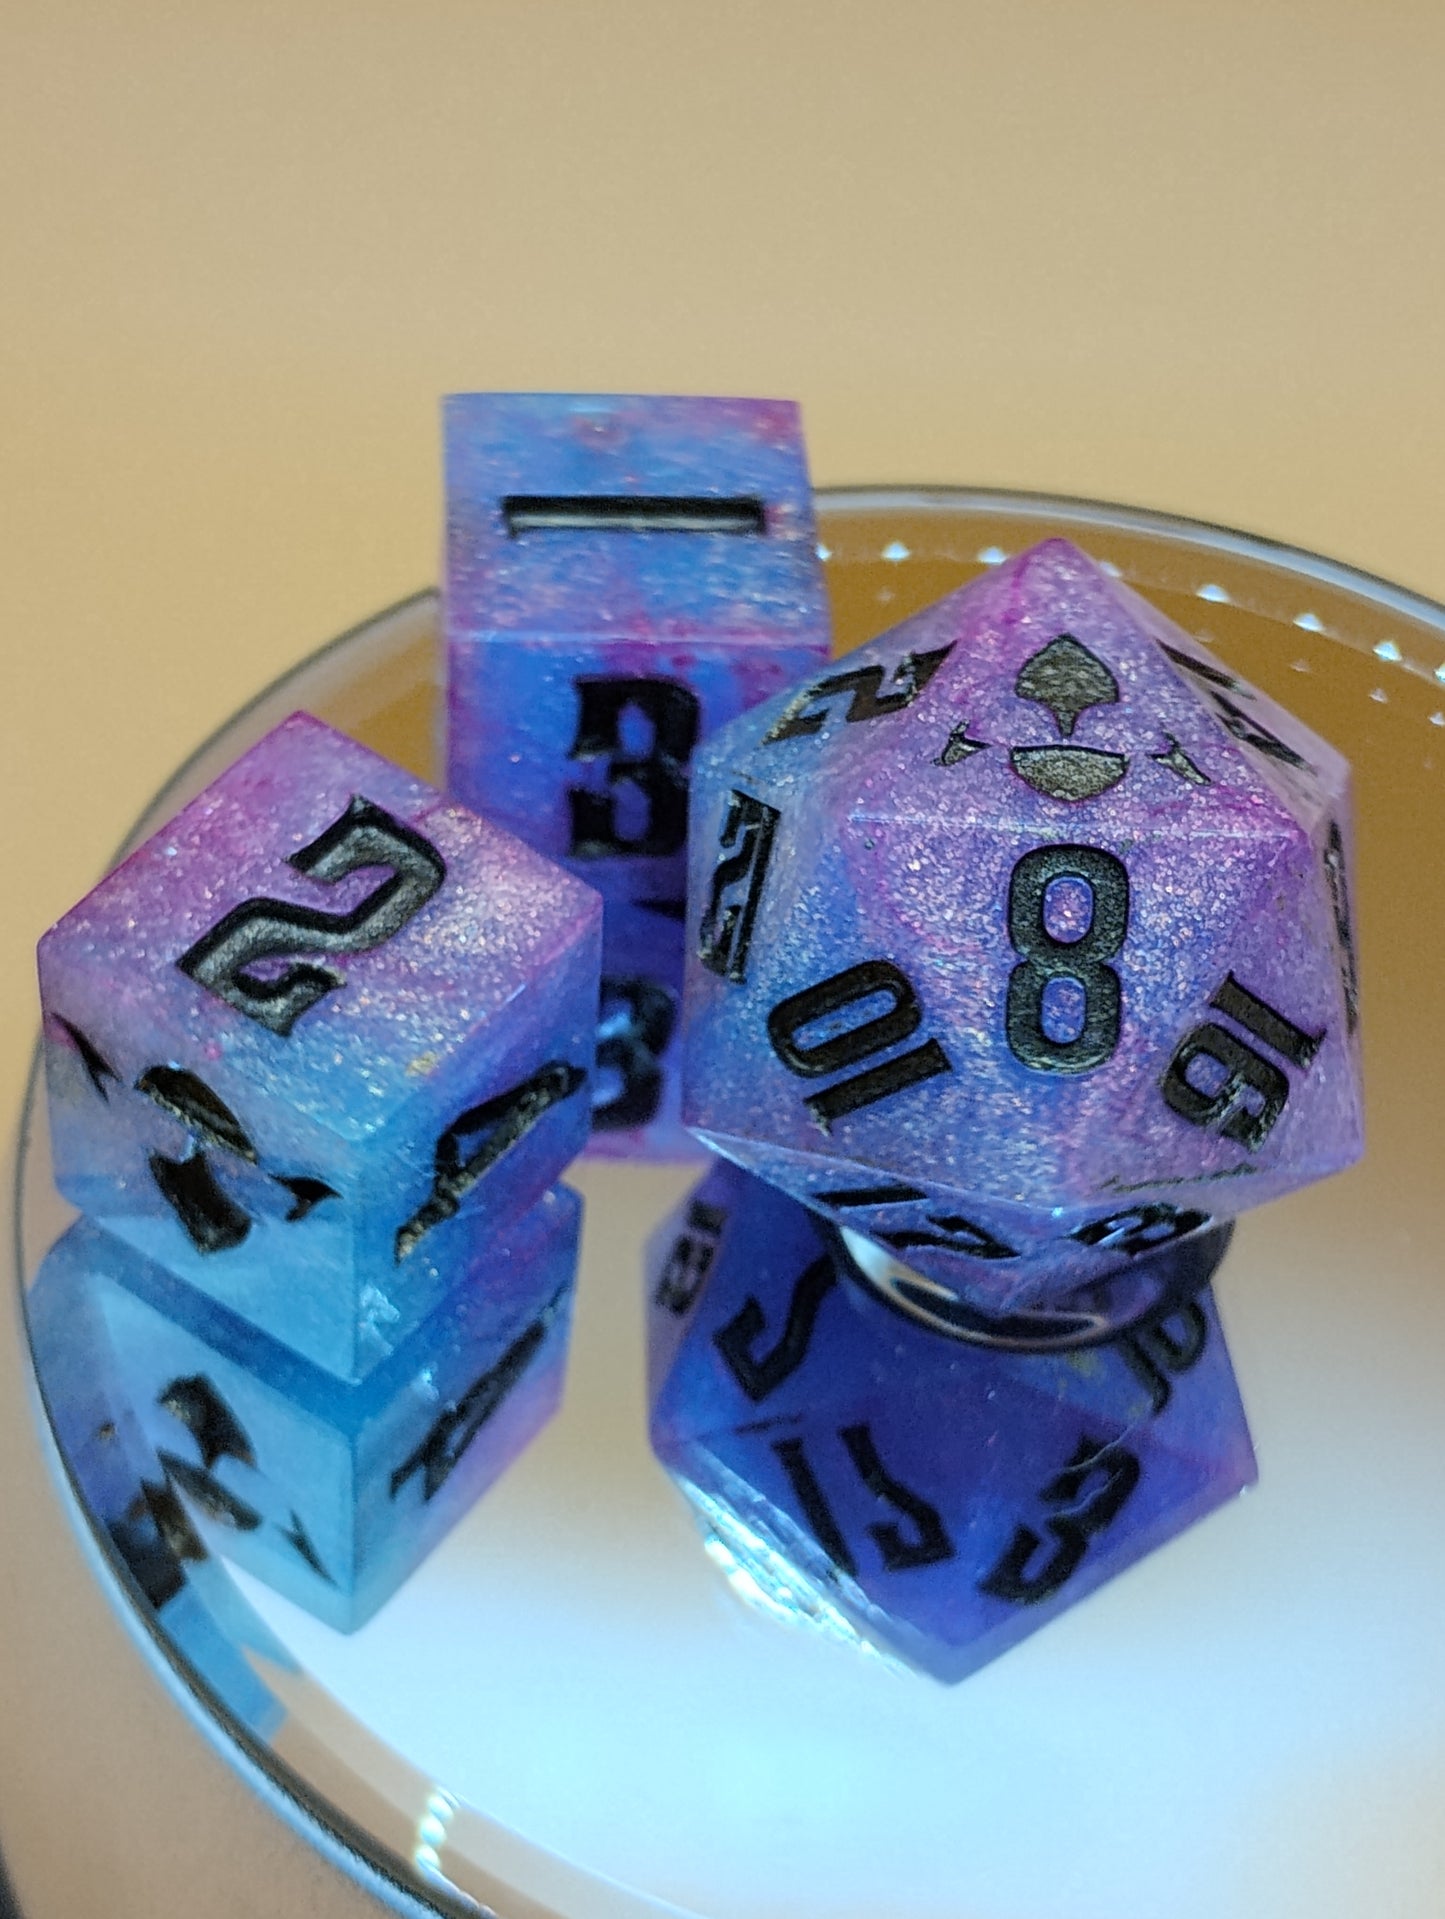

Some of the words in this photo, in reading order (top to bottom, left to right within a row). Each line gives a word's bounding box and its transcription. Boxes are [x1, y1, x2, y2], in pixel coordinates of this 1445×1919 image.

[180, 796, 446, 1037] 2
[1007, 843, 1129, 1074] 8
[767, 959, 952, 1137] 10
[1160, 970, 1328, 1151] 16
